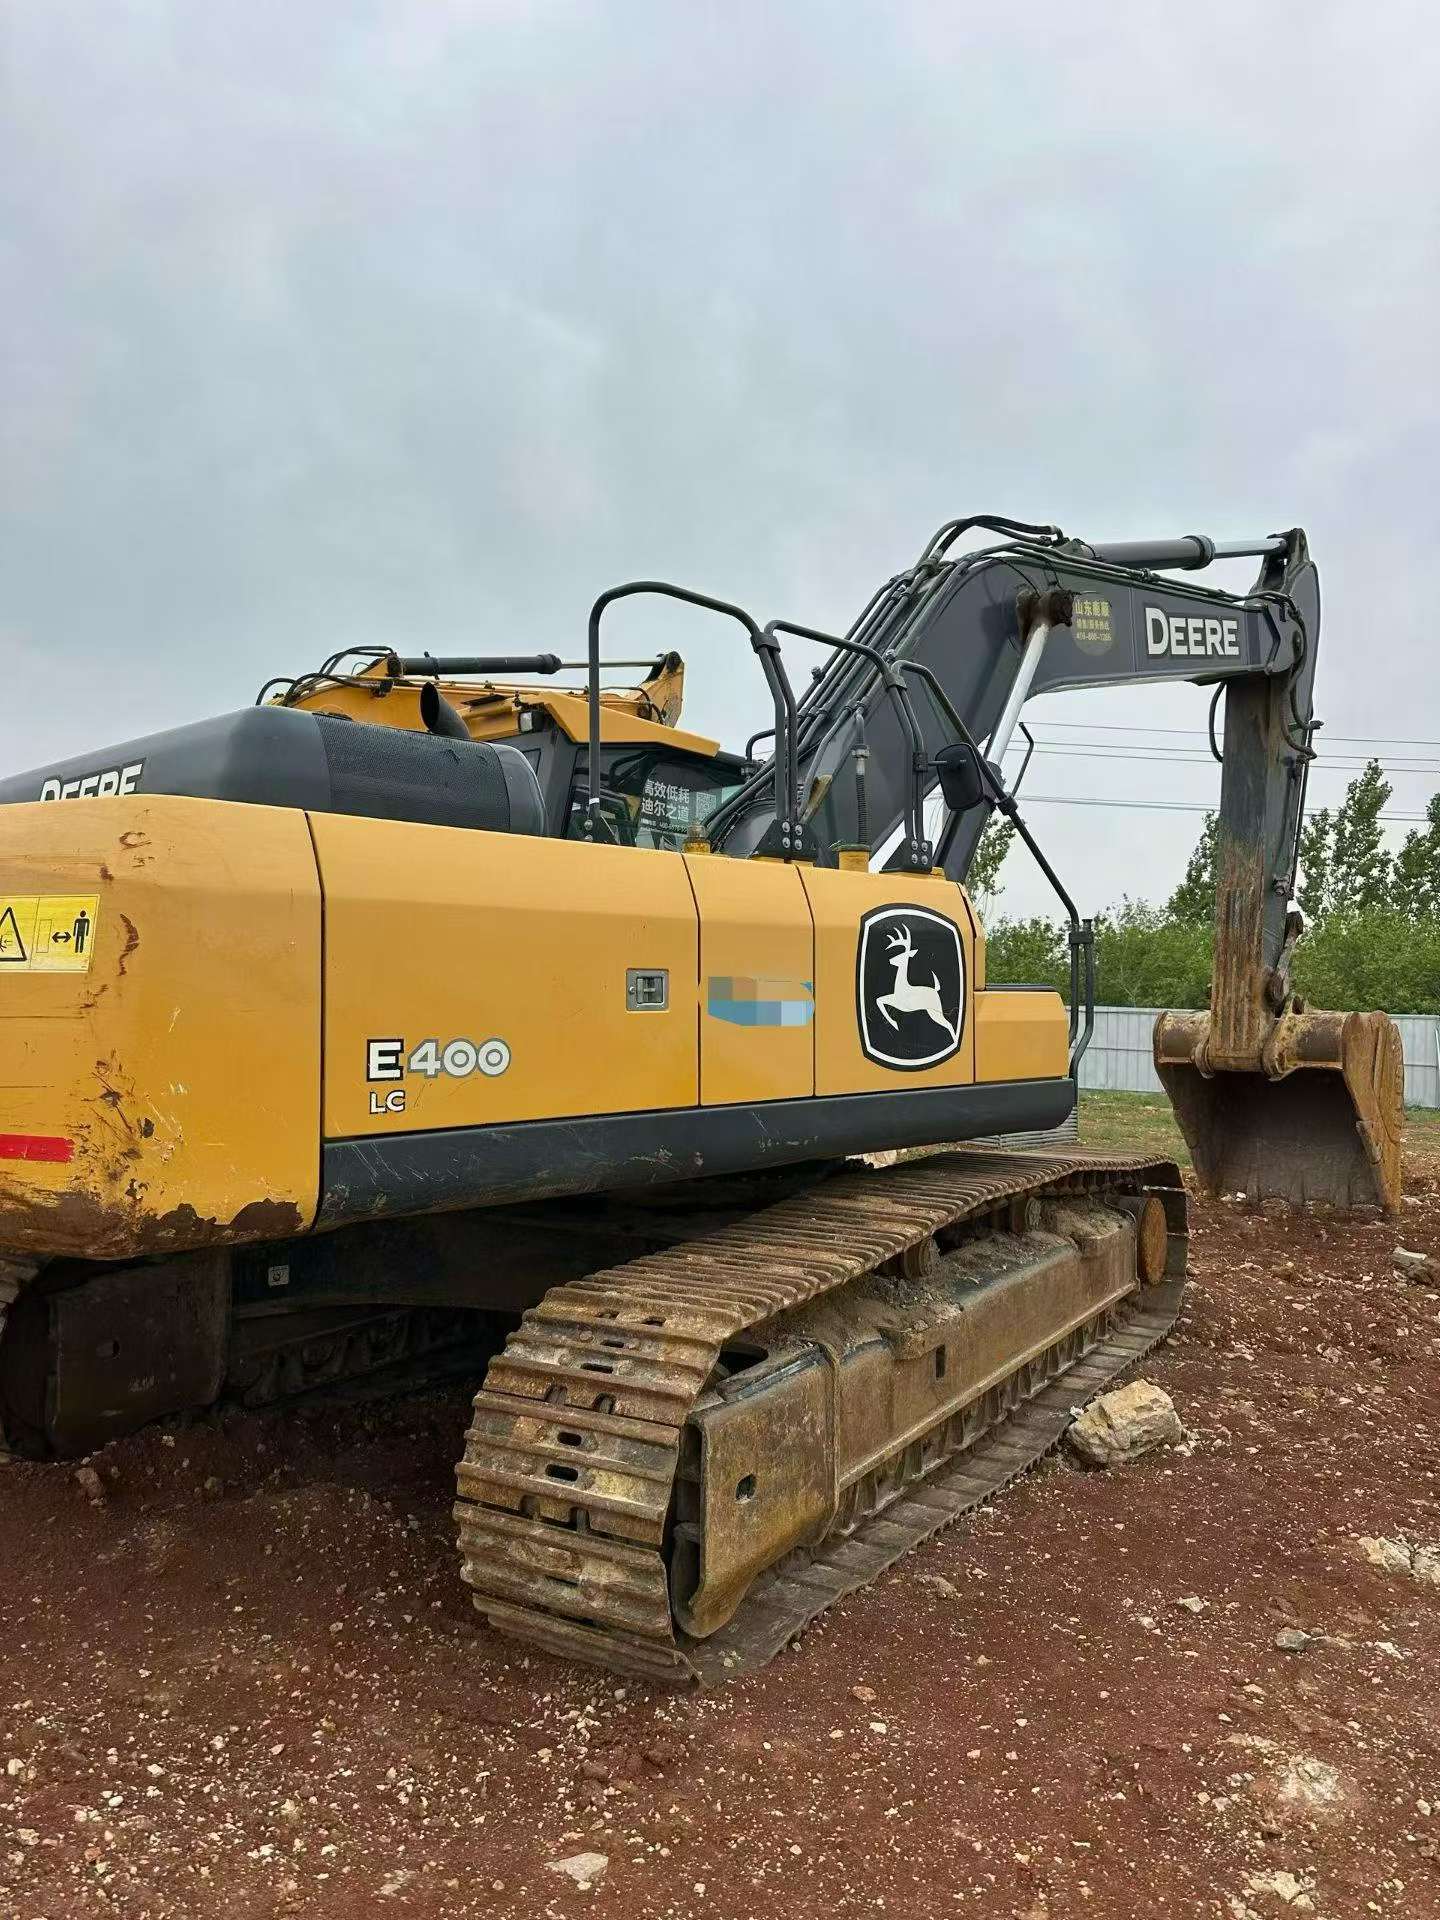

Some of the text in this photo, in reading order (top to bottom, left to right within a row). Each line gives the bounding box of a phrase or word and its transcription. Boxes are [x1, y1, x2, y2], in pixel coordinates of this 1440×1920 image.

[1145, 607, 1239, 655] DEERE
[644, 779, 690, 803] 高效低耗
[641, 798, 690, 822] 迪尔之道
[369, 1089, 405, 1114] LC
